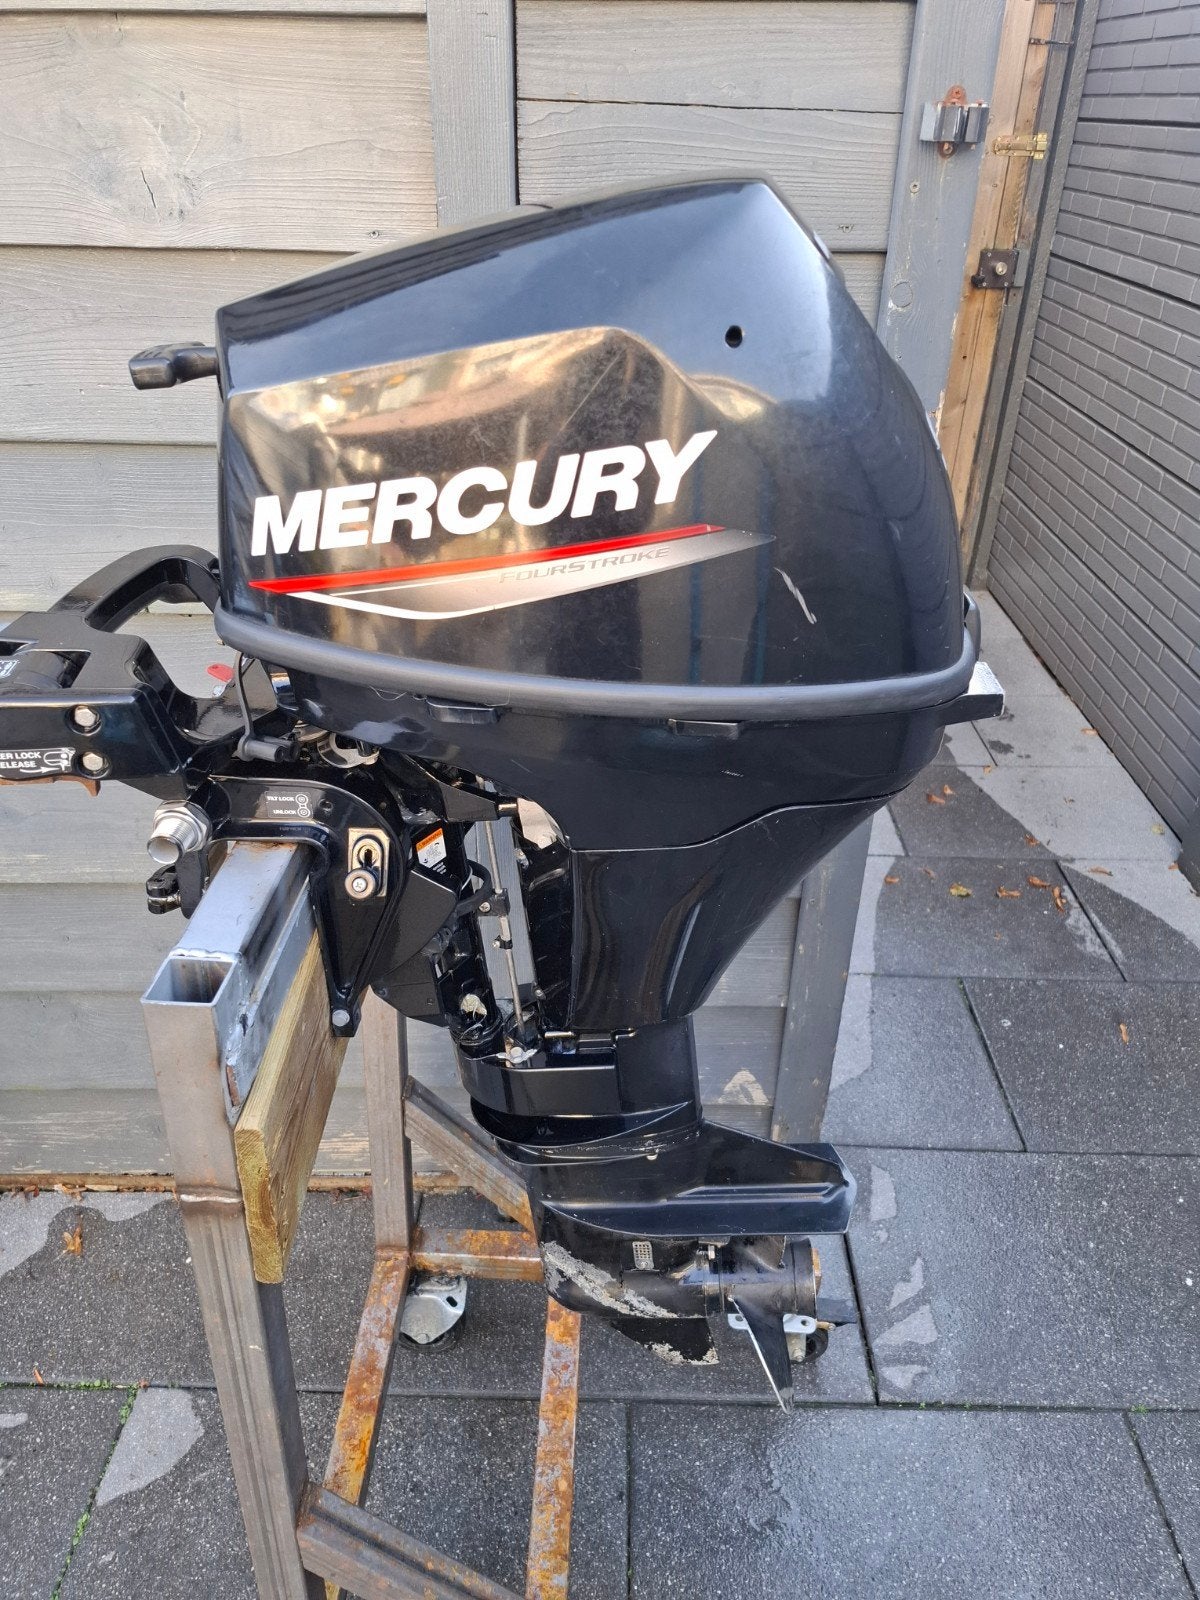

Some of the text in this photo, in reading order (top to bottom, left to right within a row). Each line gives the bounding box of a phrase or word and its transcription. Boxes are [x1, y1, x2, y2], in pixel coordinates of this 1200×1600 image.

[251, 430, 718, 557] MERCURY
[499, 547, 670, 583] FOURSTROKE
[15, 751, 41, 760] LOCK
